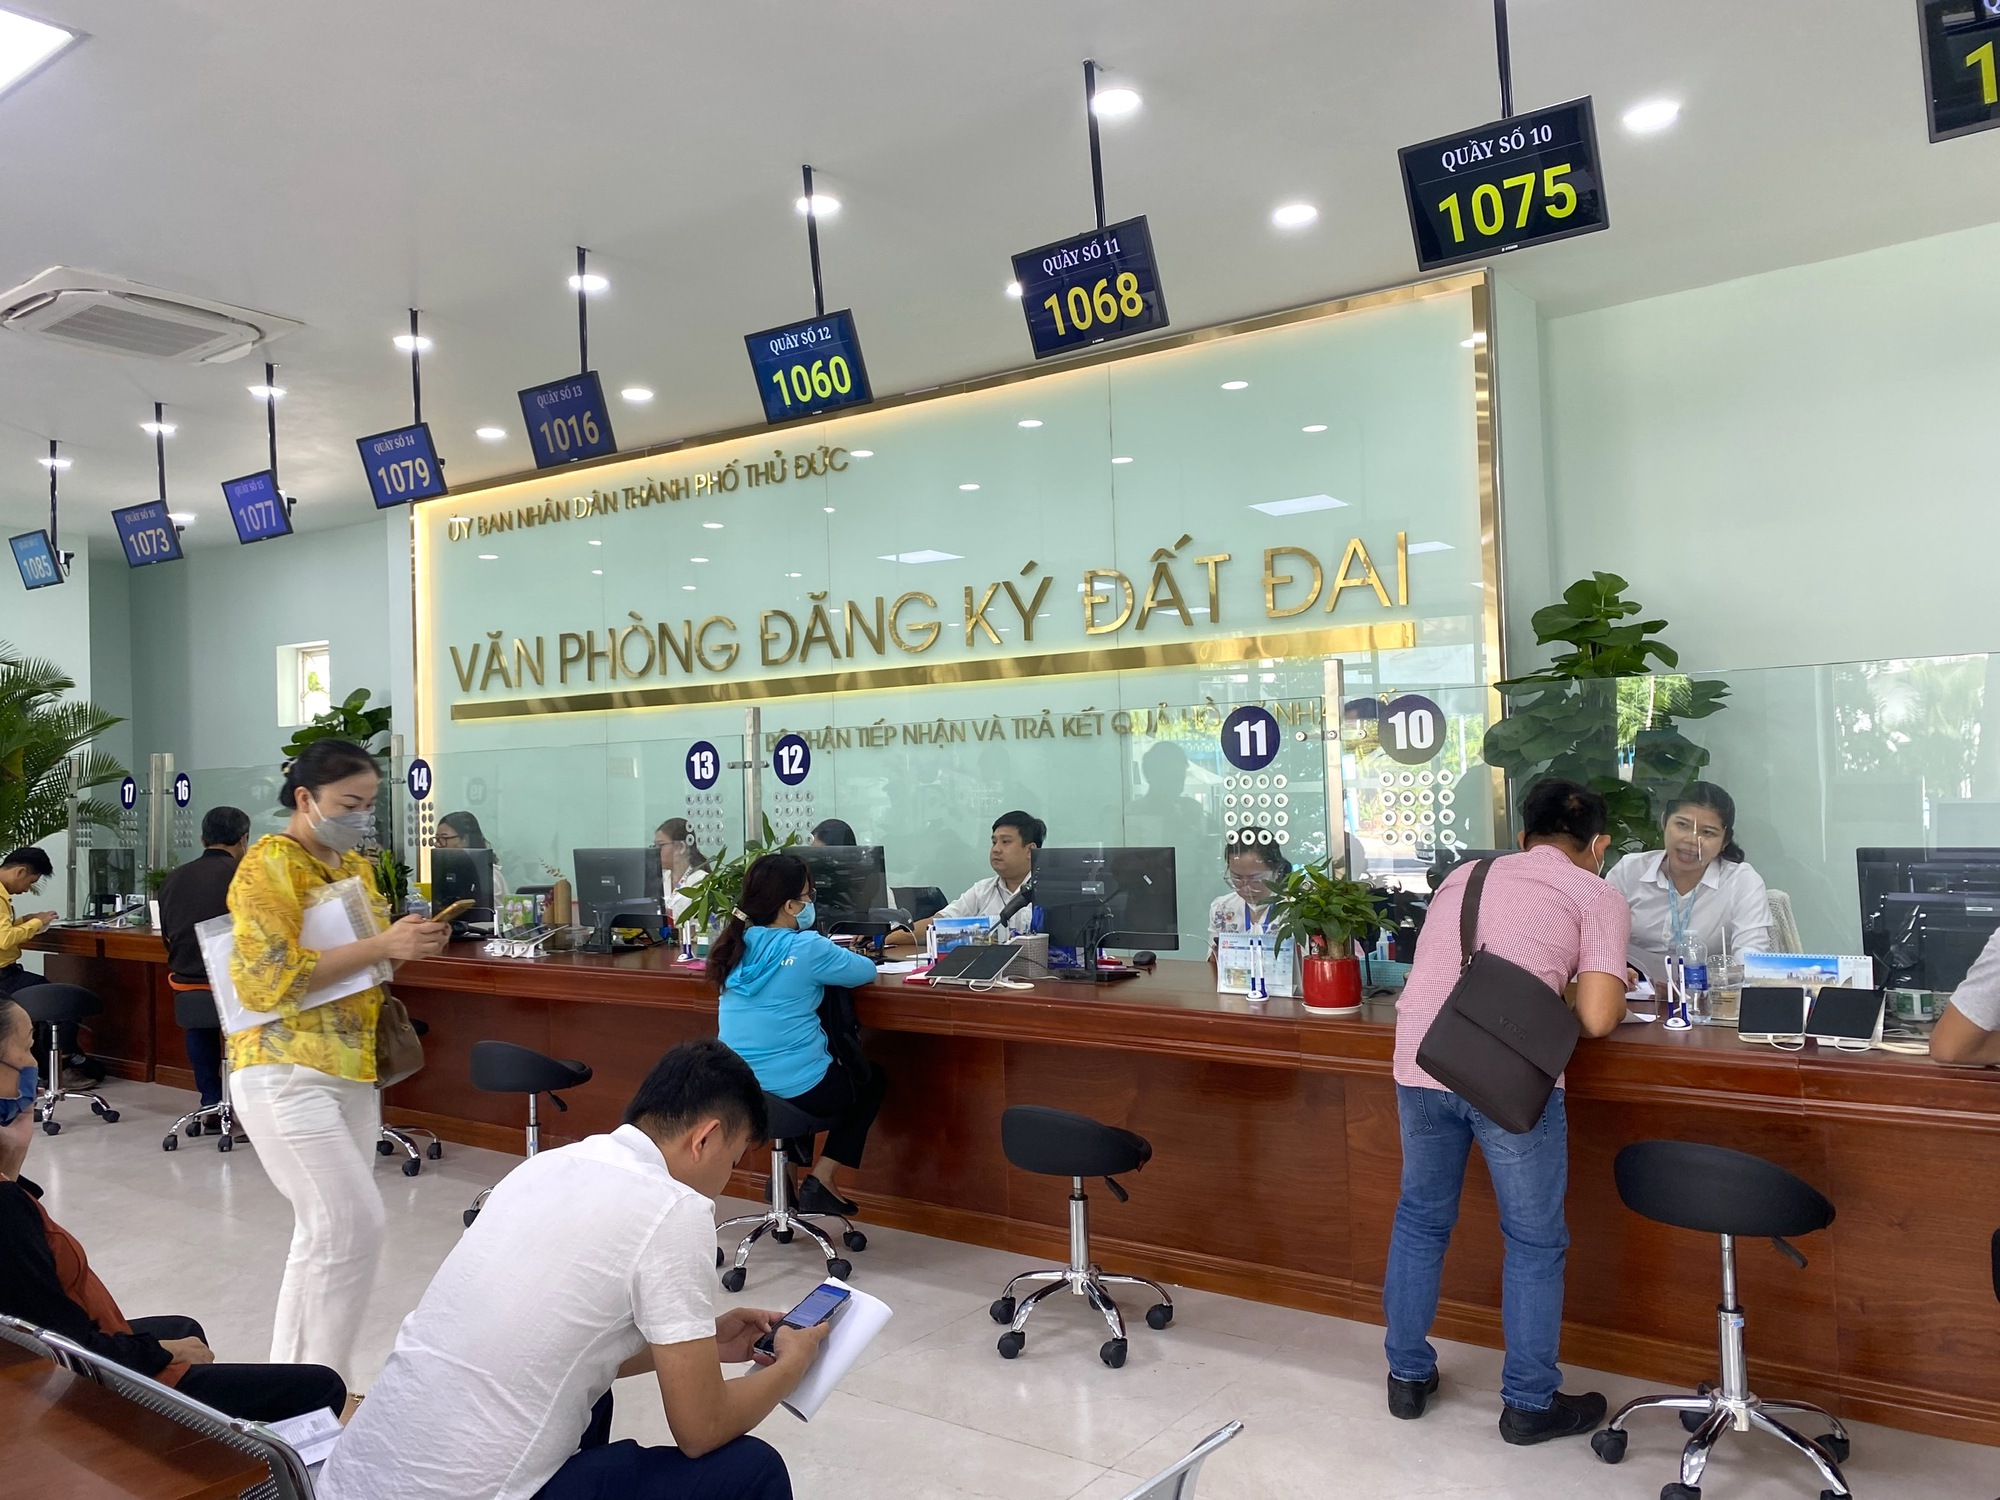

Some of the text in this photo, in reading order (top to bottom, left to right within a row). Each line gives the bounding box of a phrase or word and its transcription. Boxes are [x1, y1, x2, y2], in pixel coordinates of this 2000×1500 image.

[1441, 124, 1553, 172] QUẦY SỐ 10
[1438, 163, 1578, 243] 1075
[1042, 238, 1121, 276] QUẦY SỐ 11
[1043, 272, 1144, 336] 1068
[769, 326, 832, 356] QUẦY SỐ 12
[572, 385, 583, 397] 13
[772, 355, 852, 407] 1060
[406, 434, 415, 446] 14
[540, 410, 600, 453] 1016
[377, 457, 431, 495] 1079
[447, 445, 850, 542] ỦY BAN NHÂN DÂN THÀNH PHỐ THỦ ĐỨC
[238, 500, 277, 532] 1077
[129, 527, 170, 557] 1073
[23, 555, 52, 580] 1085
[449, 530, 1409, 694] VĂN PHÒNG ĐĂNG KÝ ĐẤT ĐAI
[855, 718, 897, 748] TIẾP
[902, 718, 967, 749] NHẬN
[972, 714, 1006, 742] VÀ
[1011, 708, 1055, 740] TRẢ
[1062, 706, 1105, 738] KẾT
[1274, 699, 1328, 726] NH
[1233, 718, 1268, 757] 11
[1387, 708, 1435, 751] 10
[690, 750, 715, 780] 13
[778, 744, 804, 775] 12
[123, 783, 134, 803] 17
[176, 779, 189, 801] 16
[411, 767, 428, 791] 14
